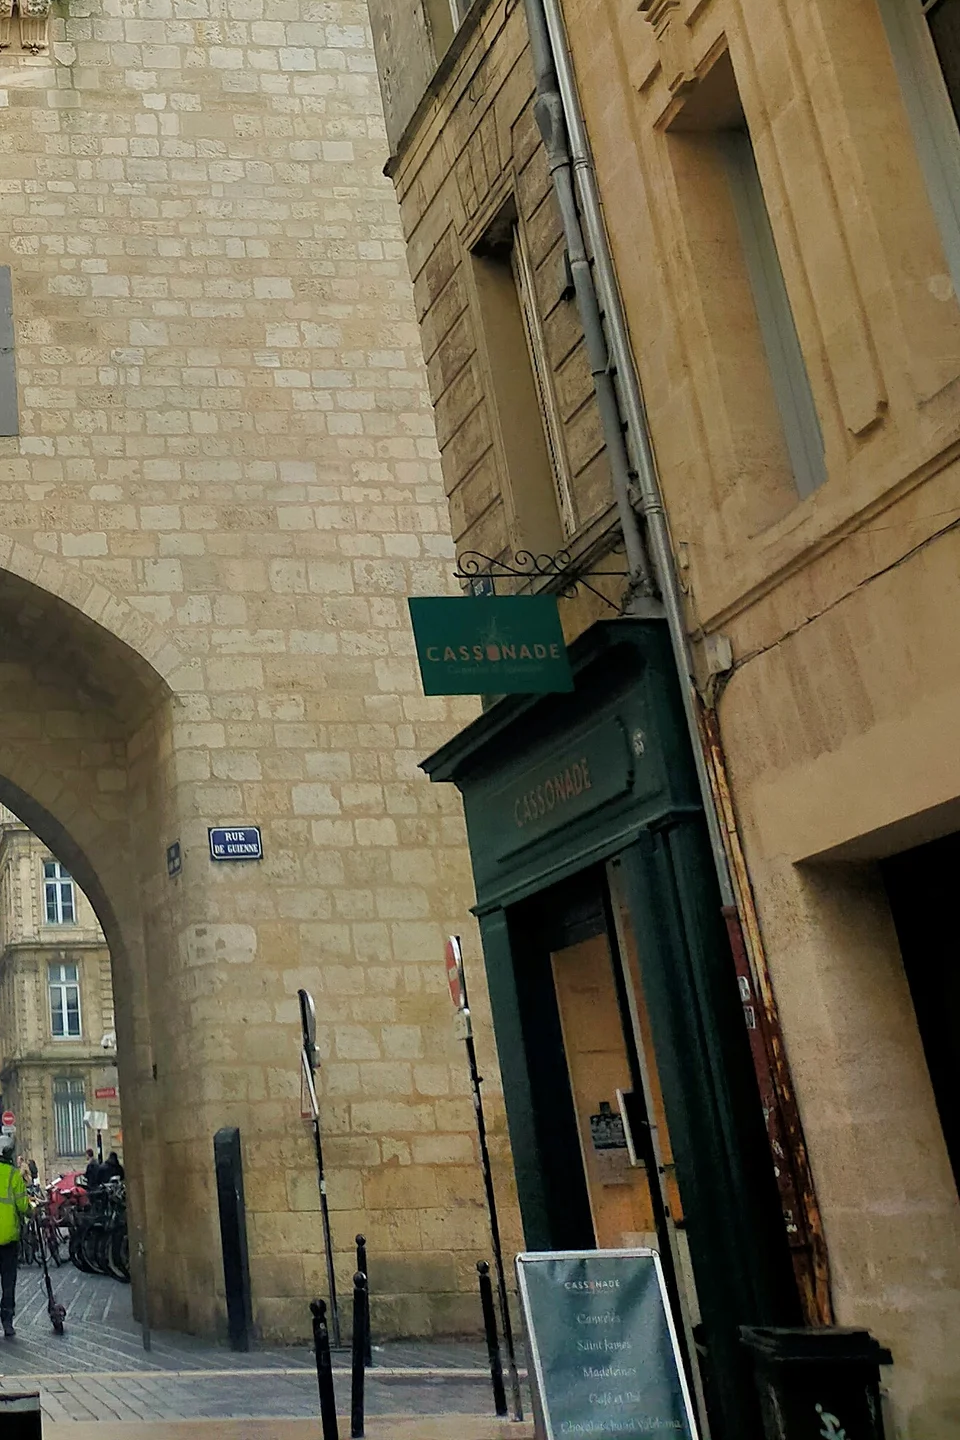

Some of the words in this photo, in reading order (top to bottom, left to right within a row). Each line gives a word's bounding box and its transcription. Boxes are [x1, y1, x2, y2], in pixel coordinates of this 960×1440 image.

[426, 643, 561, 662] CASSONADE
[514, 757, 592, 827] CASSONADE
[225, 831, 246, 841] RUE
[214, 844, 226, 854] DE
[227, 843, 259, 854] GUIENNE
